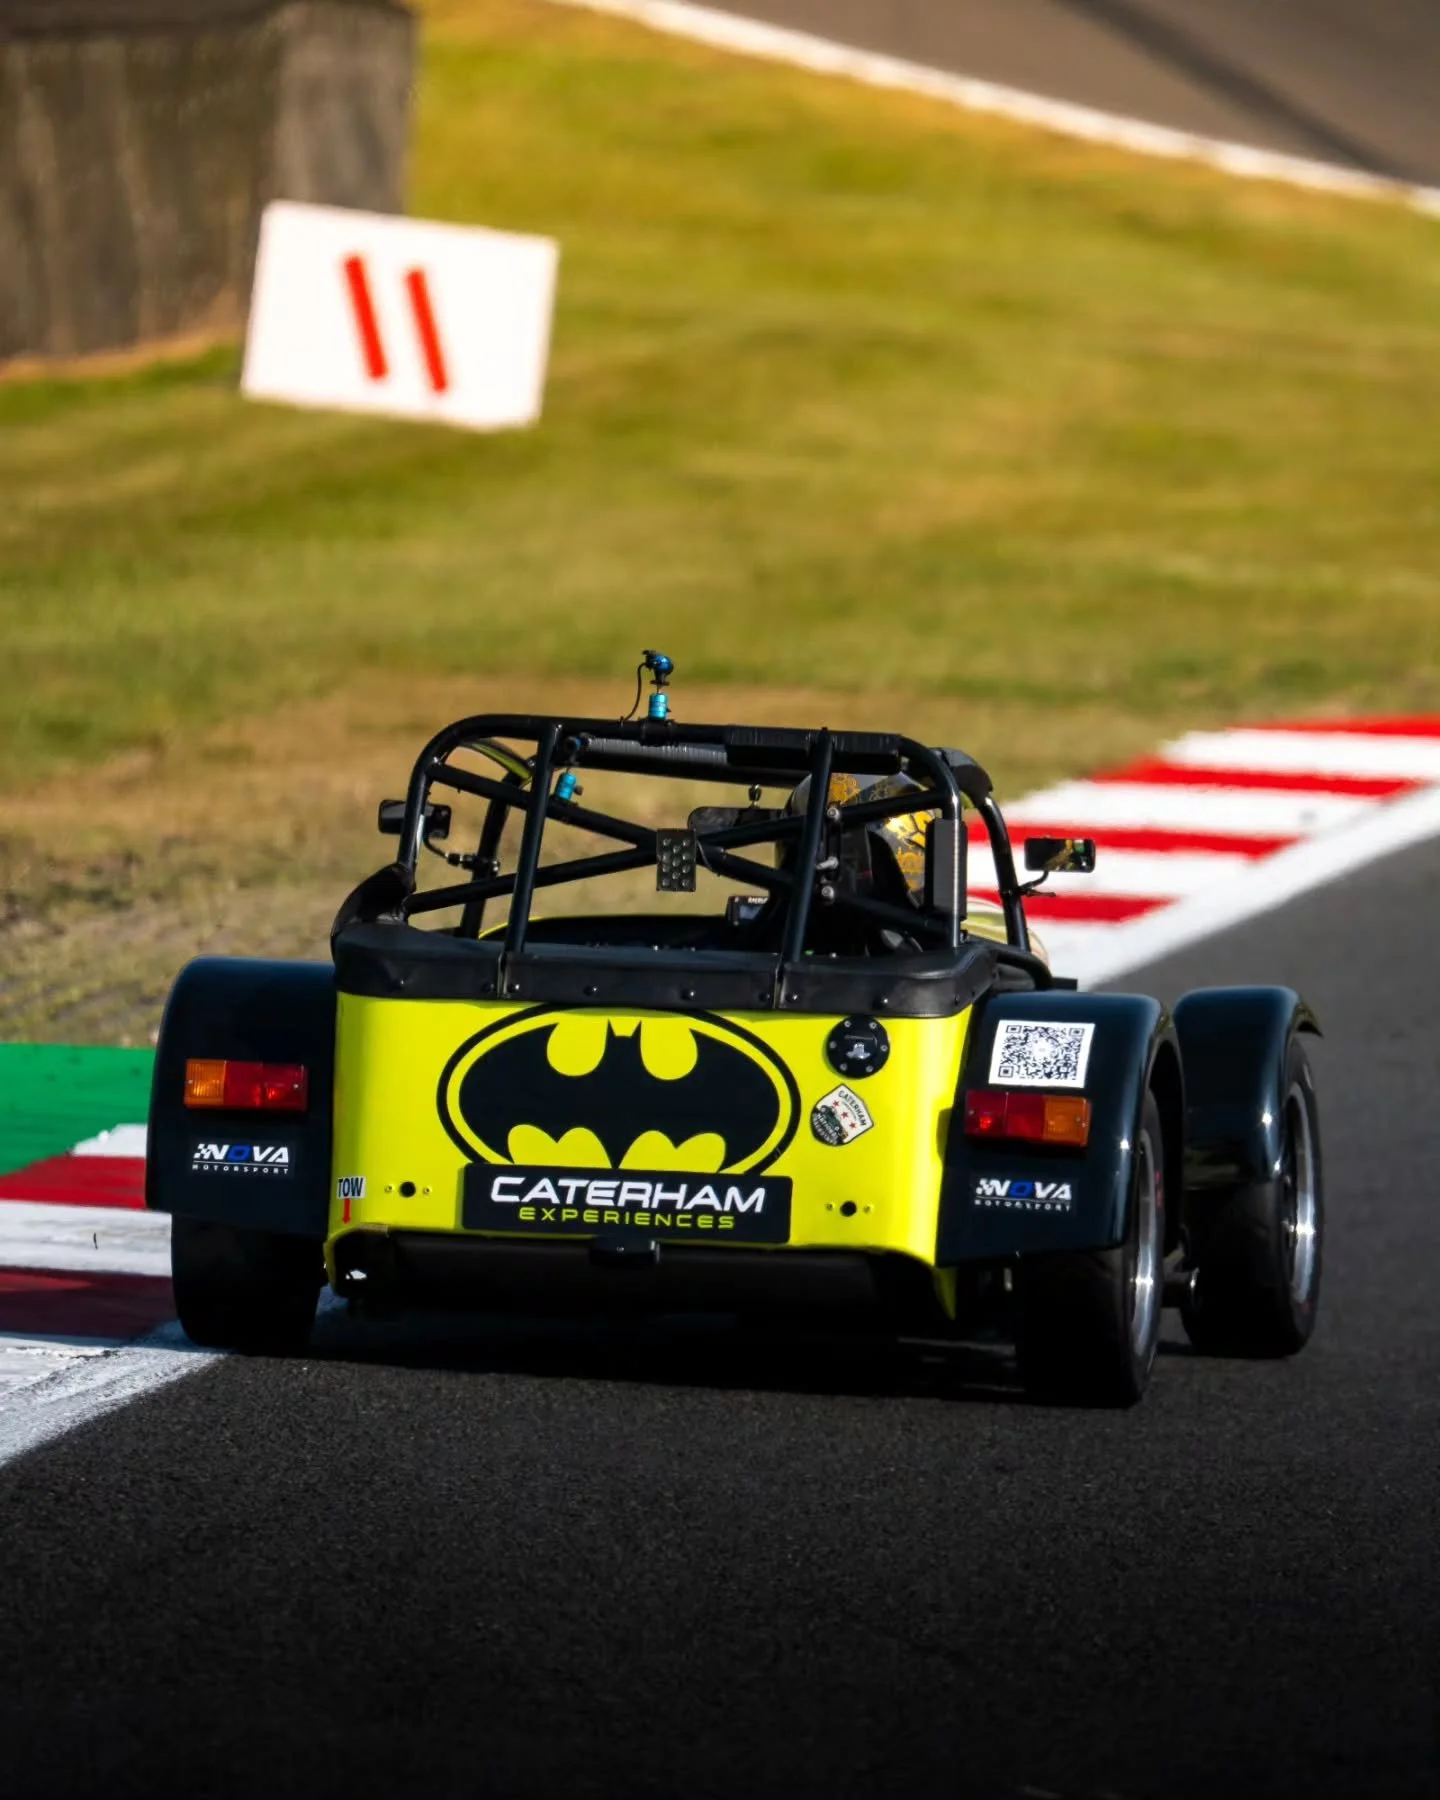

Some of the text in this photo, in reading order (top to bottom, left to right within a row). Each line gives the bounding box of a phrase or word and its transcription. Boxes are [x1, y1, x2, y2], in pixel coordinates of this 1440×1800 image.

[839, 1090, 867, 1126] CATERHAM
[203, 1143, 289, 1163] NOVA
[191, 1164, 289, 1175] MOTORSPORT
[338, 1177, 364, 1198] TOW
[489, 1175, 766, 1214] CATERHAM
[986, 1179, 1072, 1201] NOVA
[518, 1206, 735, 1229] EXPERIENCES
